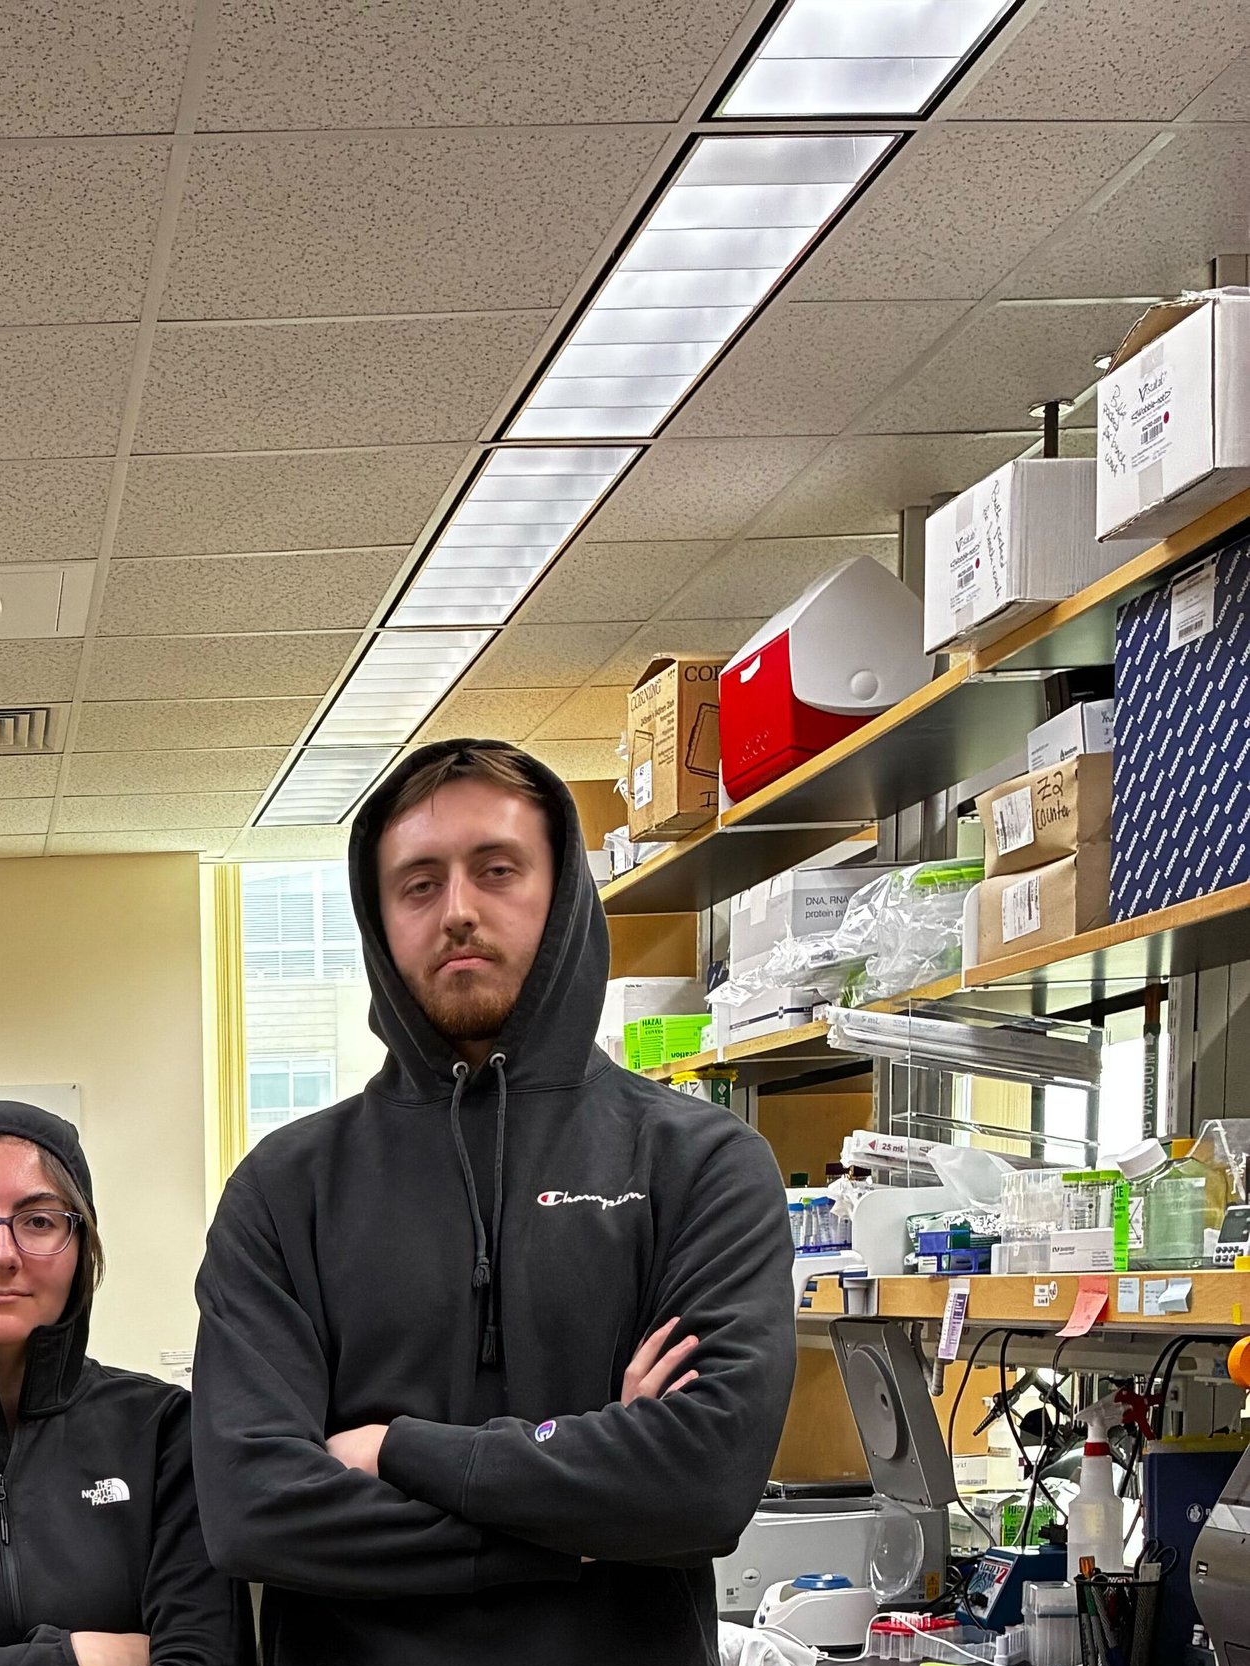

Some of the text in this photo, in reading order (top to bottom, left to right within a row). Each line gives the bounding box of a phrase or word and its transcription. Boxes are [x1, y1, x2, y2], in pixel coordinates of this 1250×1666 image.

[1144, 592, 1159, 624] QIAGEN
[1216, 595, 1232, 628] QIAGEN
[1126, 616, 1140, 648] QIAGEN
[1153, 609, 1169, 641] QIAGEN
[1227, 613, 1244, 647] QIAGEN
[1135, 633, 1150, 665] QIAGEN
[1174, 645, 1190, 678] QIAGEN
[1206, 638, 1223, 672] QIAGEN
[1117, 657, 1132, 688] QIAGEN
[1145, 651, 1160, 683] QIAGEN
[1185, 663, 1201, 696] QIAGEN
[1218, 656, 1235, 690] QIAGEN
[1127, 674, 1141, 706] QIAGEN
[1156, 668, 1170, 701] QIAGEN
[1197, 681, 1213, 714] QIAGEN
[1231, 676, 1248, 709] QIAGEN
[1137, 692, 1151, 724] QIAGEN
[1166, 686, 1182, 719] QIAGEN
[1208, 700, 1226, 734] QIAGEN
[1120, 715, 1134, 746] QIAGEN
[1147, 710, 1162, 742] QIAGEN
[1177, 705, 1193, 738] QIAGEN
[1221, 719, 1238, 752] QIAGEN
[1130, 733, 1144, 764] QIAGEN
[1158, 728, 1172, 760] QIAGEN
[1188, 723, 1204, 756] QIAGEN
[1140, 751, 1154, 782] QIAGEN
[1168, 747, 1184, 779] QIAGEN
[1200, 742, 1216, 775] QIAGEN
[1122, 773, 1136, 804] QIAGEN
[1150, 769, 1165, 801] QIAGEN
[1180, 766, 1195, 798] QIAGEN
[1212, 762, 1229, 794] QIAGEN
[1132, 792, 1146, 822] QIAGEN
[1161, 788, 1176, 820] QIAGEN
[1191, 785, 1207, 817] QIAGEN
[1224, 781, 1242, 814] QIAGEN
[1116, 812, 1129, 842] QIAGEN
[1142, 810, 1157, 841] QIAGEN
[1172, 807, 1187, 839] QIAGEN
[1203, 804, 1219, 837] QIAGEN
[1125, 831, 1139, 861] QIAGEN
[1153, 829, 1168, 860] QIAGEN
[1184, 826, 1199, 858] QIAGEN
[1215, 824, 1232, 856] QIAGEN
[1135, 850, 1150, 880] QIAGEN
[1164, 848, 1179, 879] QIAGEN
[1196, 846, 1211, 878] QIAGEN
[1228, 844, 1245, 876] QIAGEN
[1118, 870, 1131, 900] QIAGEN
[1146, 868, 1160, 899] QIAGEN
[1176, 867, 1190, 898] QIAGEN
[805, 910, 833, 919] protein
[1143, 1052, 1156, 1116] VACUUM
[892, 1144, 905, 1153] mL
[537, 1191, 646, 1210] Champion
[81, 1486, 112, 1499] NORTH
[91, 1495, 114, 1506] FACE
[95, 1480, 112, 1489] THE
